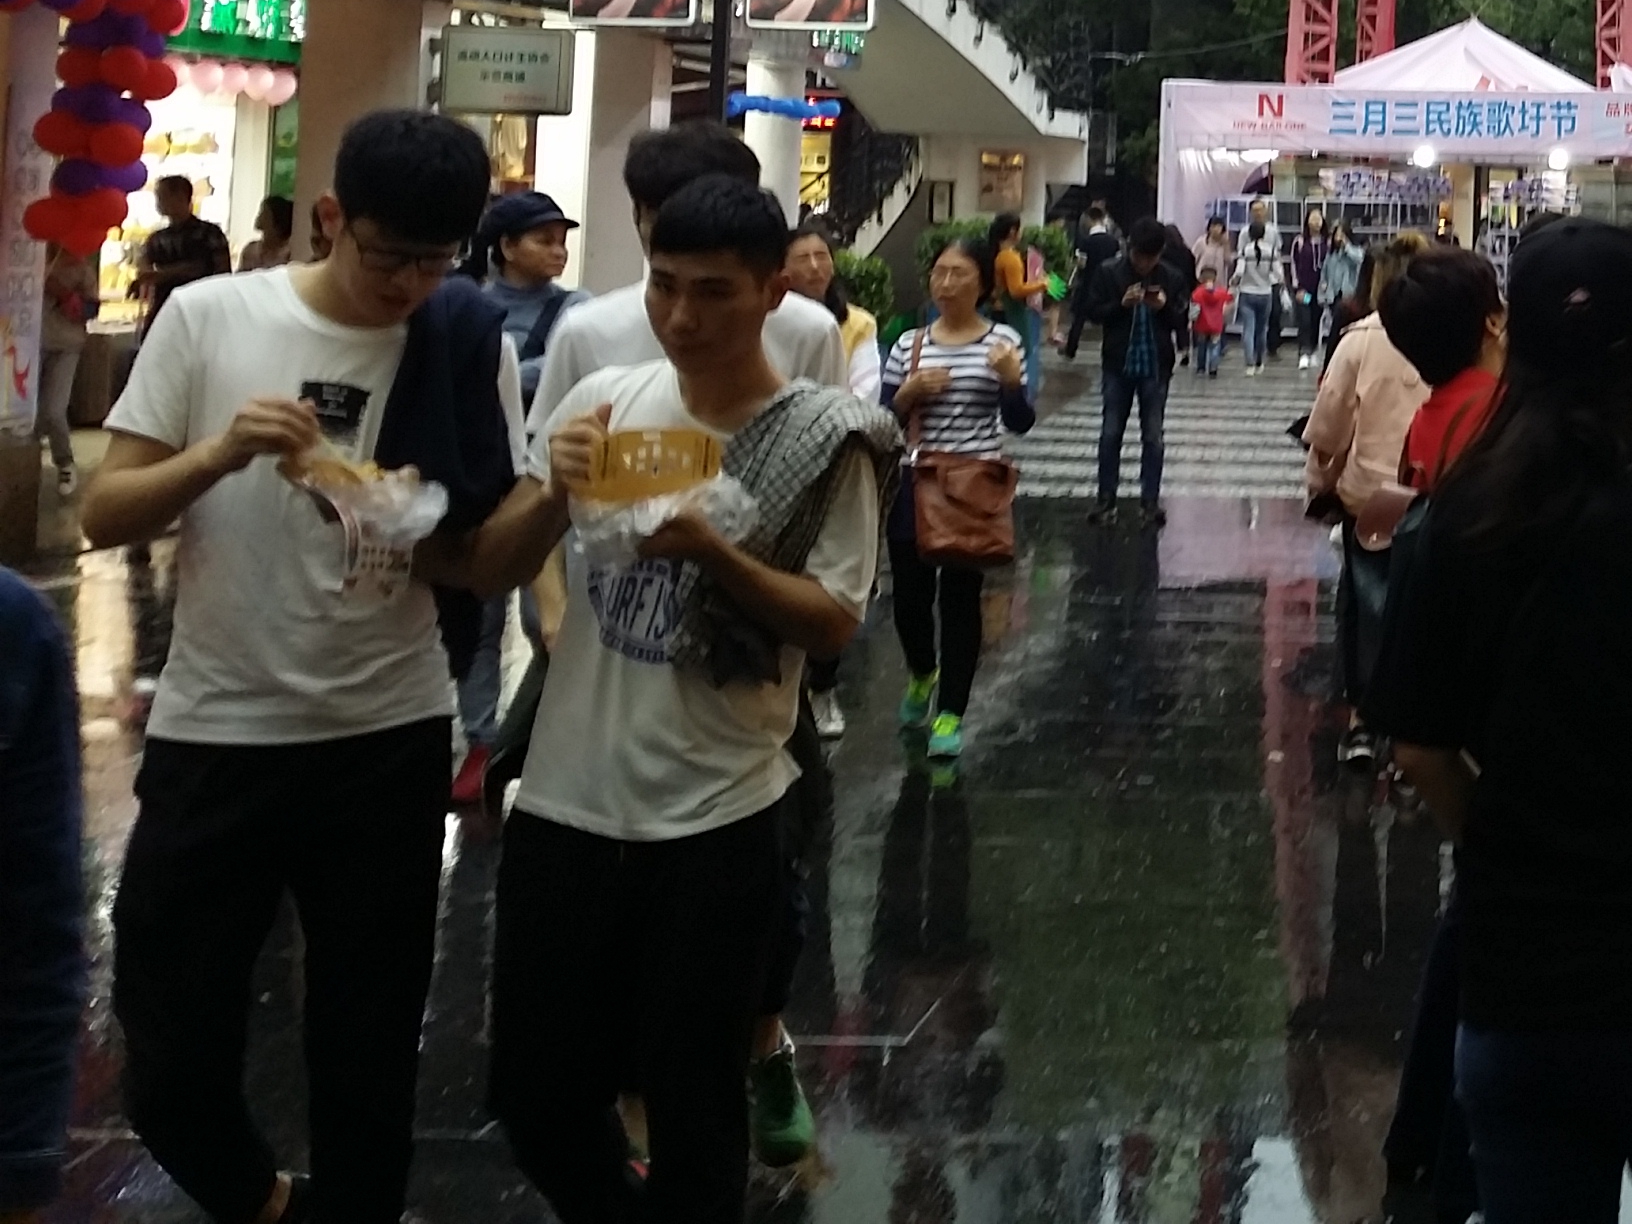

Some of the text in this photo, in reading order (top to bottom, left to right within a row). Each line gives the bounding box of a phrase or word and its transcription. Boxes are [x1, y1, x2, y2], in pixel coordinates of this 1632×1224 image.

[1258, 93, 1284, 118] N
[1329, 98, 1579, 140] 三月三民族歌圩节
